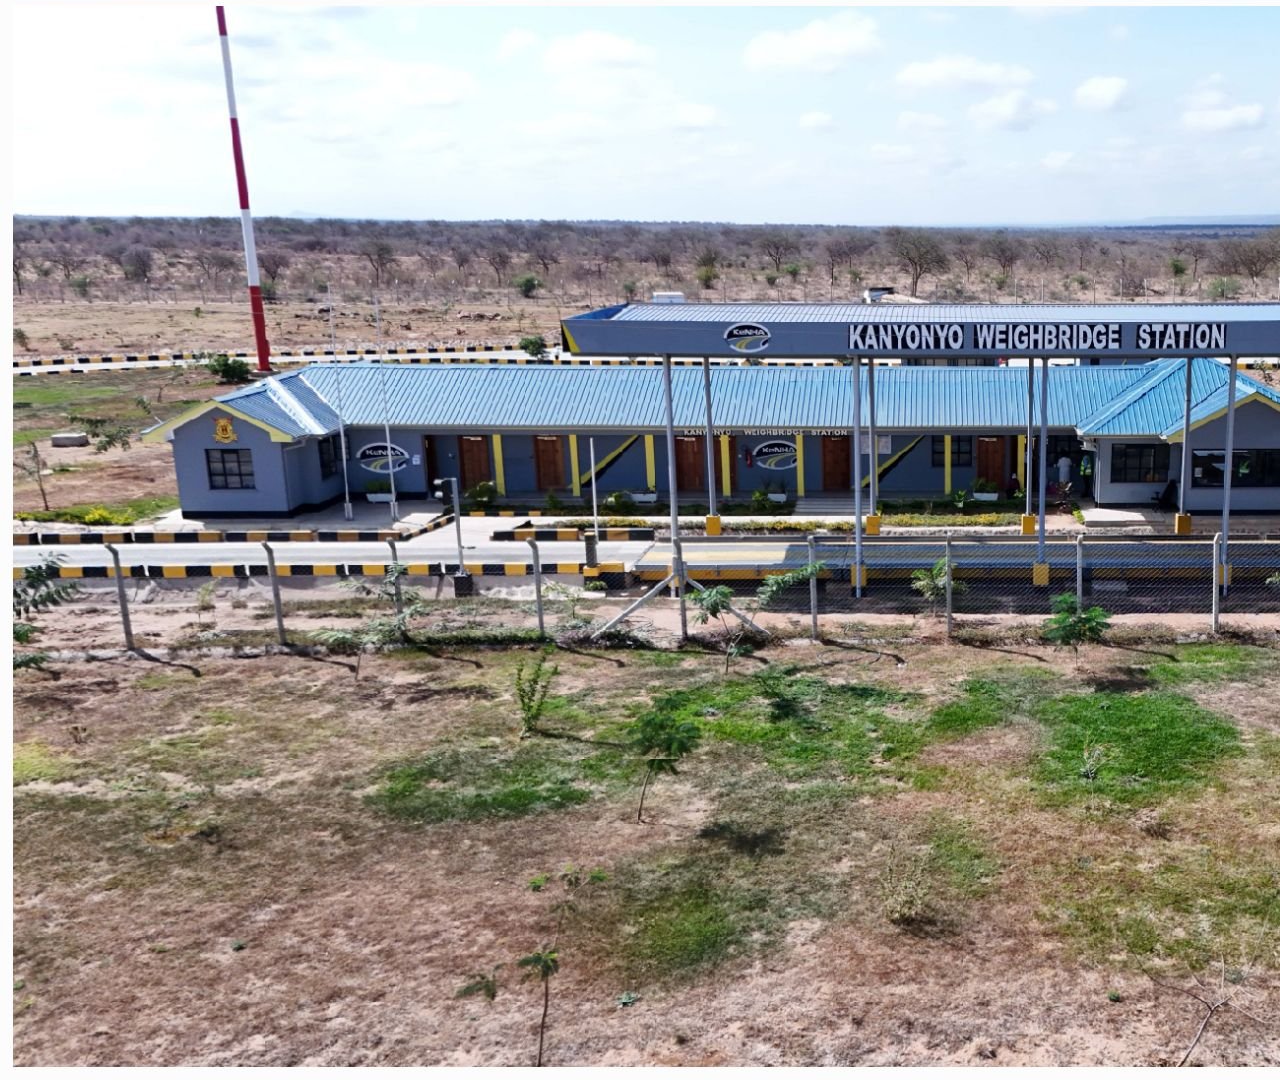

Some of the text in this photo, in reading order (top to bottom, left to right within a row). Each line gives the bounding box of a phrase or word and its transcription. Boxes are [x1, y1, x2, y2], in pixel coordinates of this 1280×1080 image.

[732, 328, 765, 336] KeNHA
[849, 323, 1225, 350] KANYONYO WEIGHBRIDGE STATION
[683, 428, 732, 436] KANYNYO
[810, 428, 848, 436] STATION
